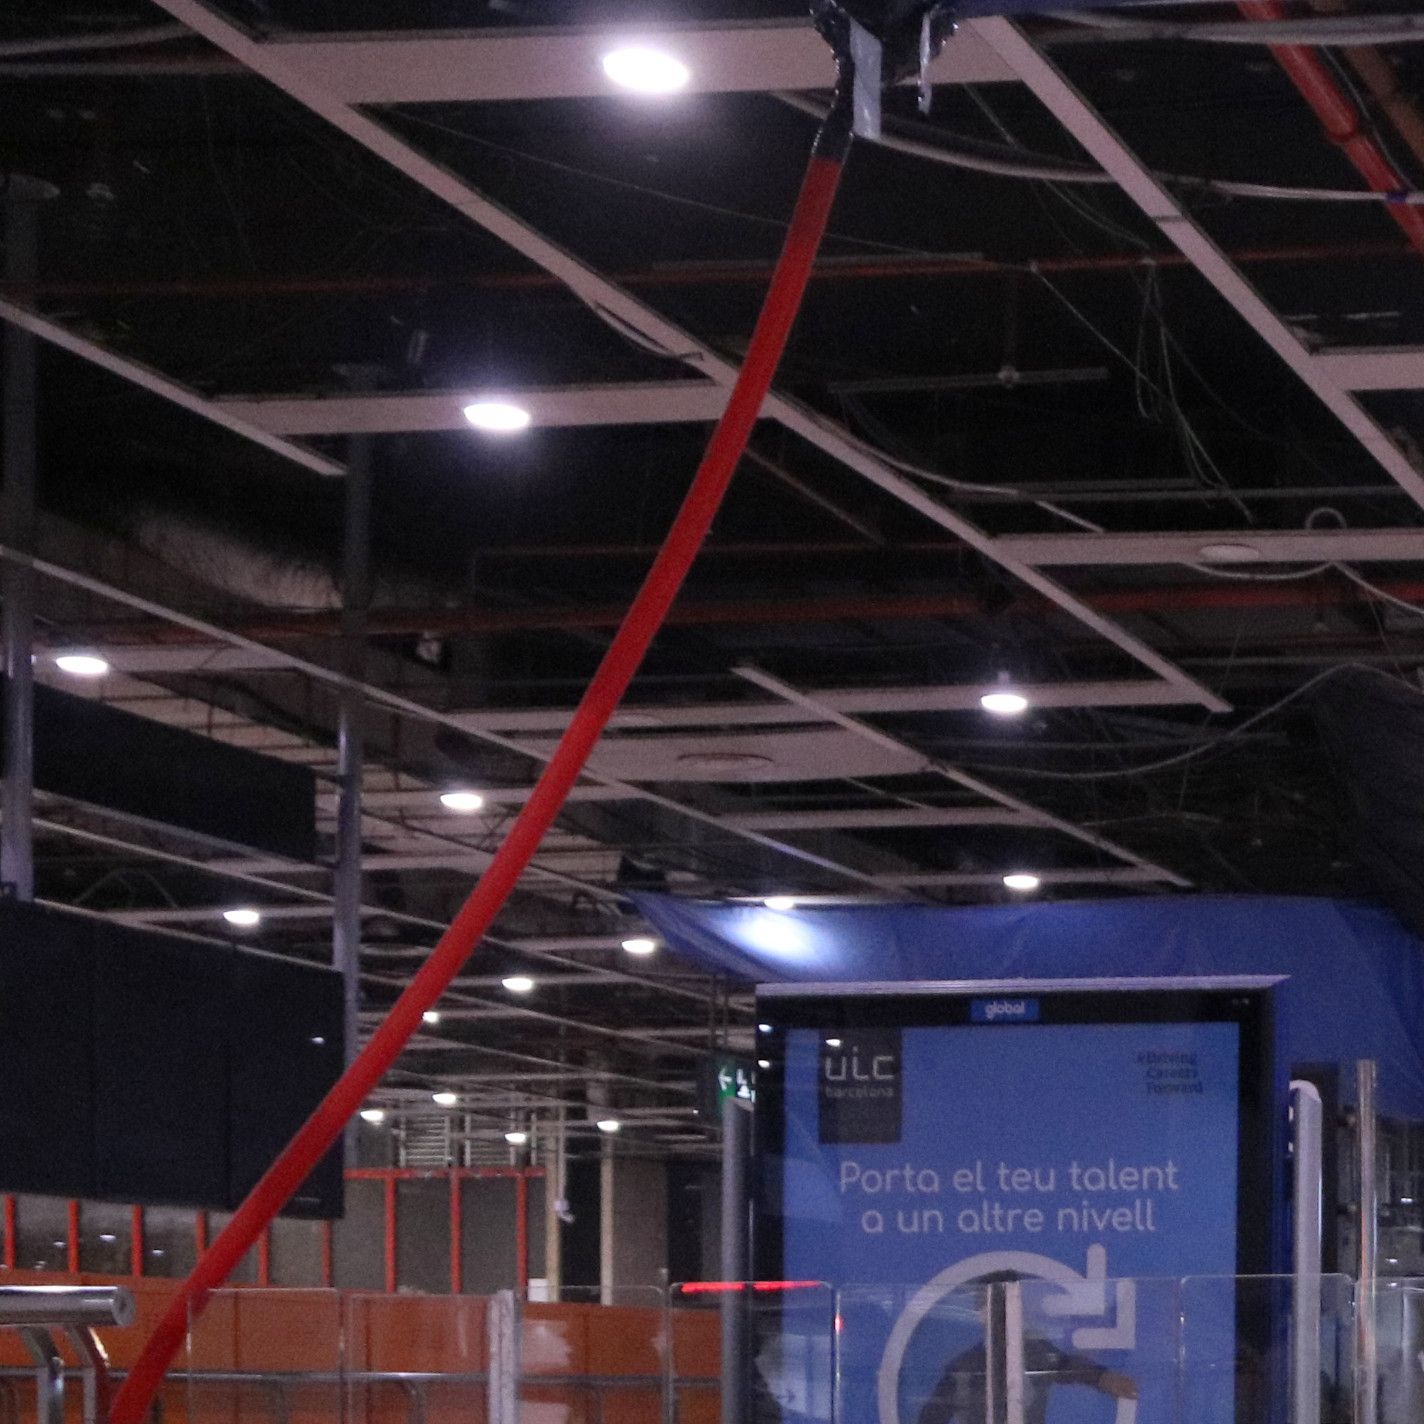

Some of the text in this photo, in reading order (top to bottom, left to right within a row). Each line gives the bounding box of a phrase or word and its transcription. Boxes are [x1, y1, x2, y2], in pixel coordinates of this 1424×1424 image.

[985, 1000, 1026, 1020] global
[825, 1085, 894, 1098] barcelona
[839, 1157, 1179, 1194] Porta el teu talent
[861, 1198, 1156, 1233] a un altre nivell
